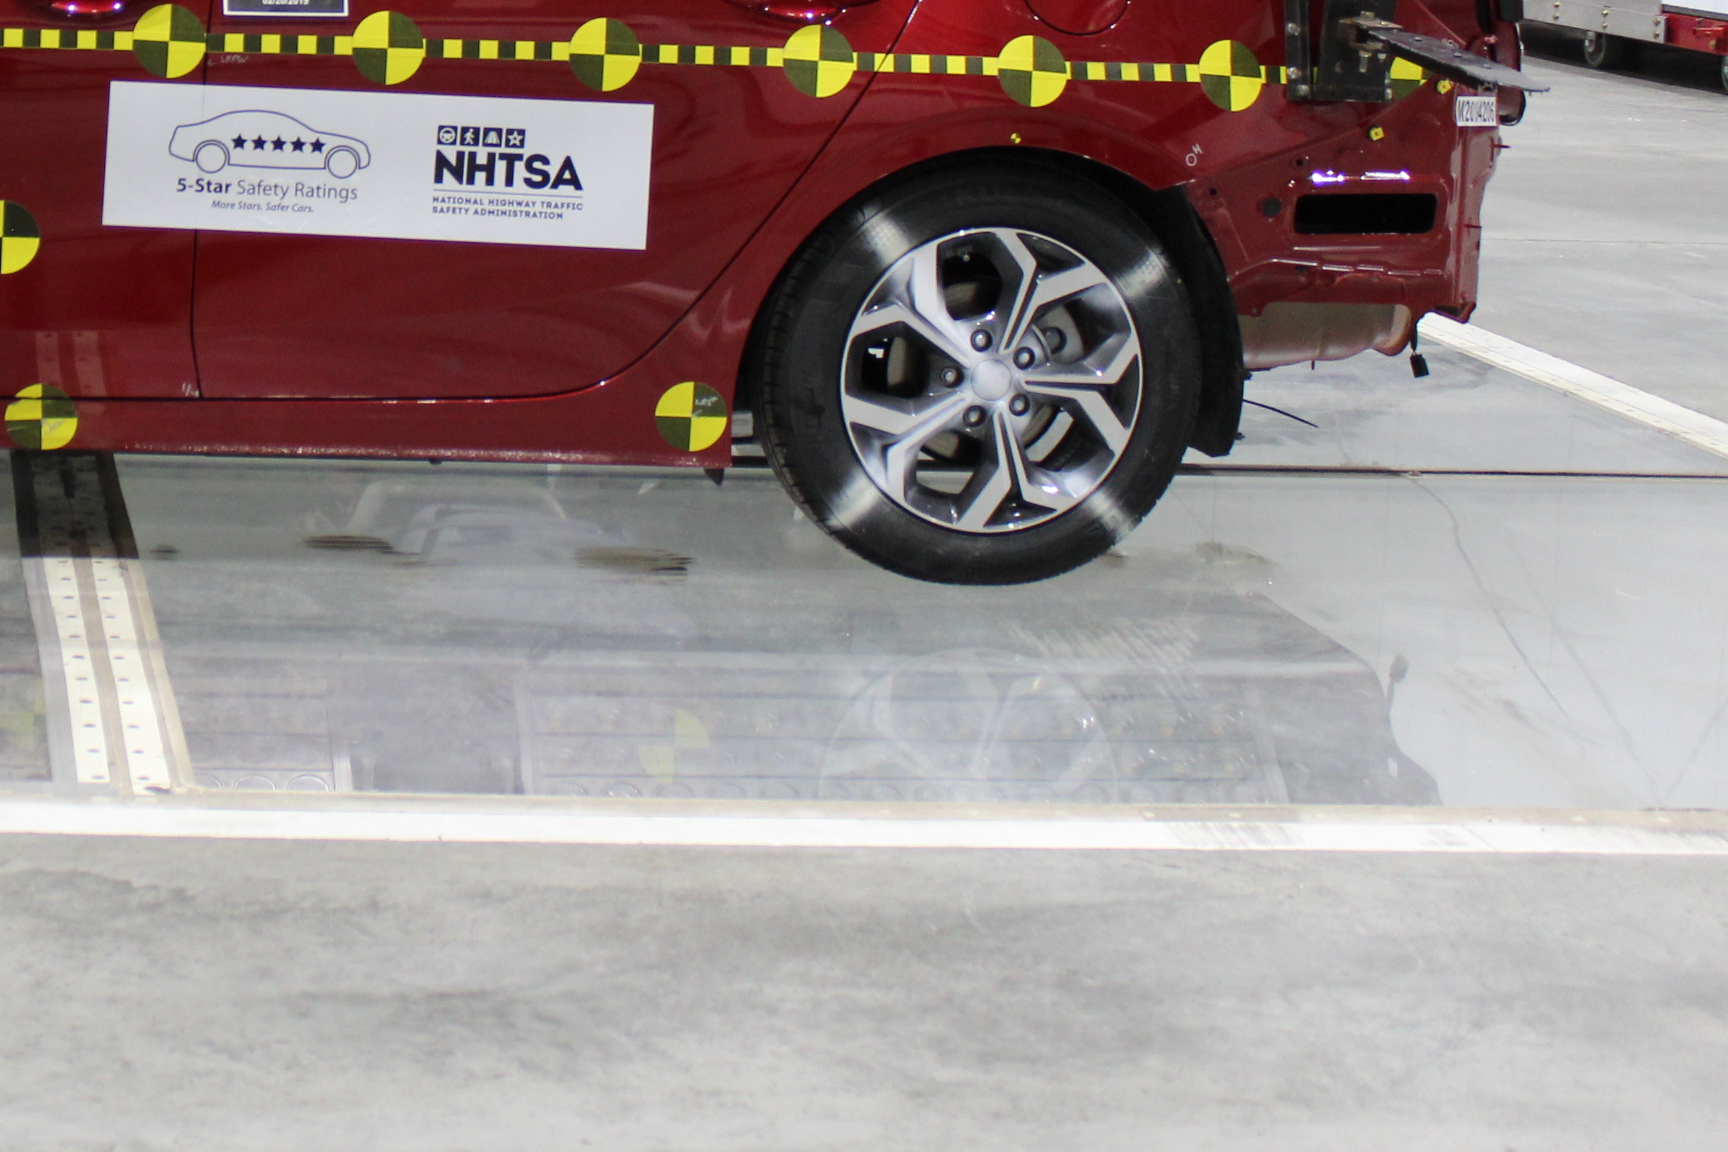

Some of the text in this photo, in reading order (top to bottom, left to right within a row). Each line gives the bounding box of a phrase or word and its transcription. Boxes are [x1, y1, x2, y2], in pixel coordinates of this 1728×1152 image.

[433, 150, 584, 191] NHTSA
[176, 178, 358, 204] 5-Star Safety Ratings
[211, 200, 315, 213] More Stars. Safer Cars.
[432, 196, 584, 211] NATIONAL HIGHWAY TRAFFIC
[432, 206, 564, 220] SAFETY ADMINISTRATION
